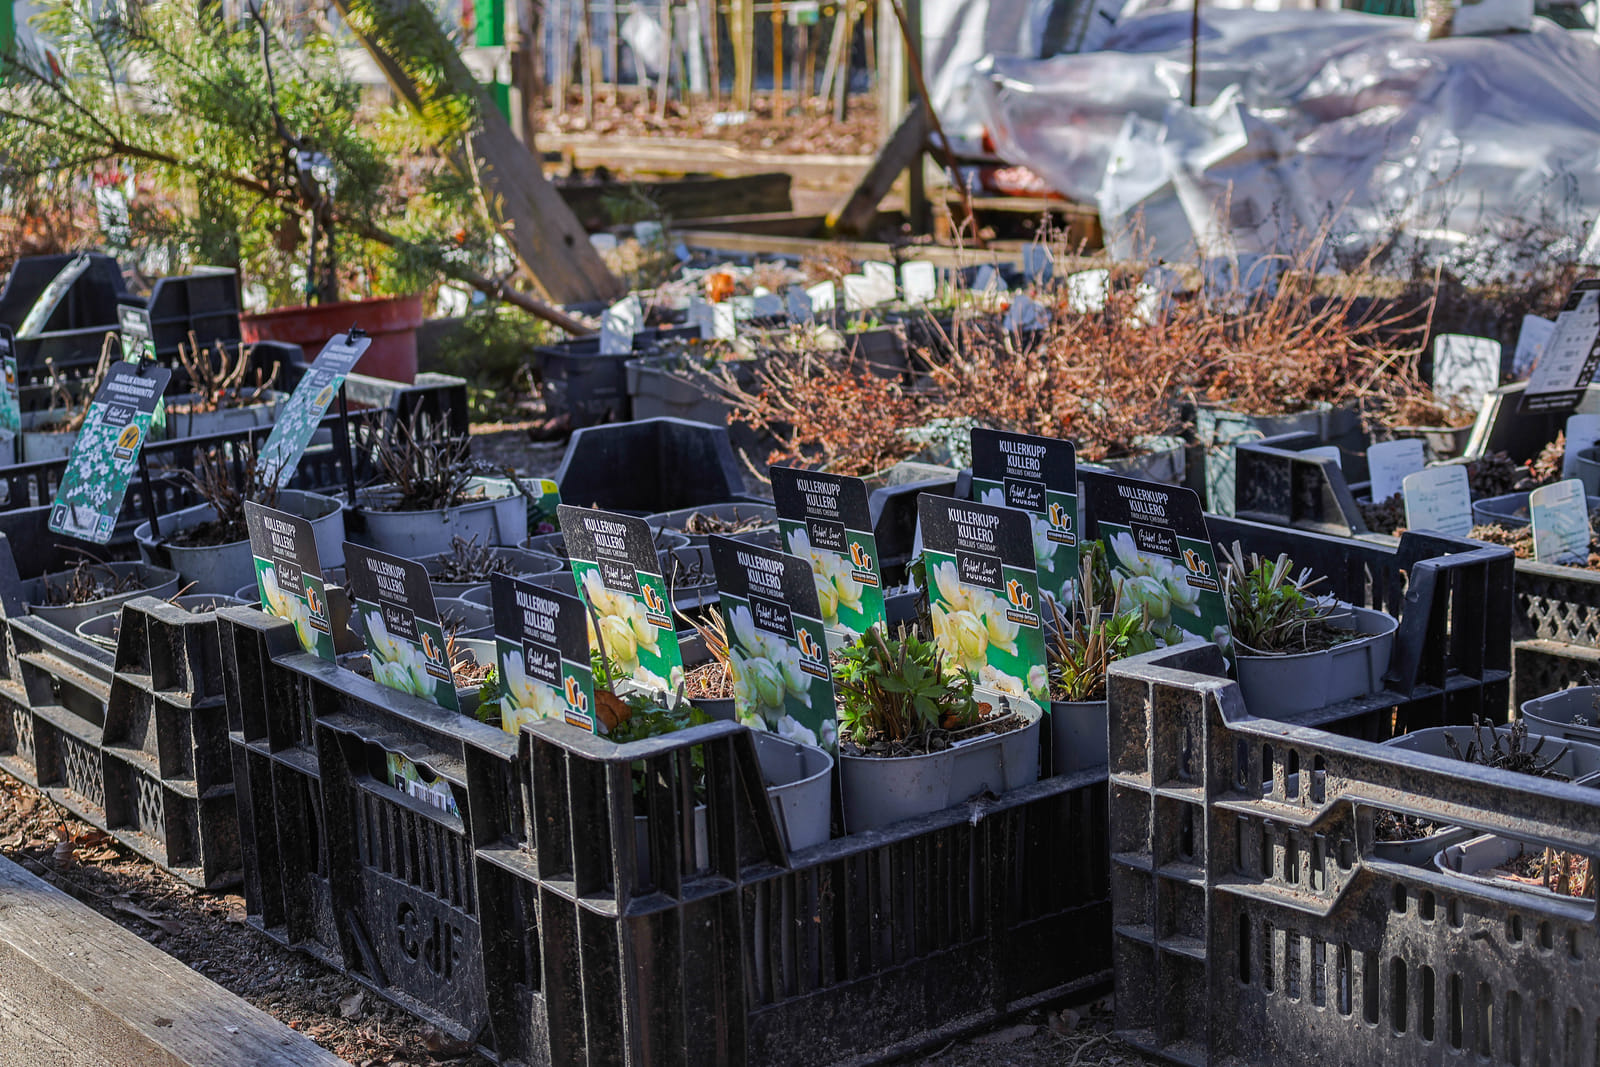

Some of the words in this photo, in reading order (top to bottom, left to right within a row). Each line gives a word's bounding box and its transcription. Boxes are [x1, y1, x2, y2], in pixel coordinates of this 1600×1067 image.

[1000, 440, 1046, 458] KULLERKUPP
[1007, 455, 1040, 470] KULLERO
[1007, 467, 1023, 476] TROLLIUS
[797, 479, 840, 496] KULLERKUPP
[1117, 485, 1169, 505] KULLERKUPP
[806, 494, 836, 509] KULLERO
[1012, 498, 1039, 507] PUUKOOL
[1129, 499, 1166, 517] KULLERO
[948, 508, 999, 529] KULLERKUPP
[1131, 512, 1149, 520] TROLLIUS
[264, 516, 296, 537] KULLERKUPP
[583, 518, 627, 537] KULLERKUPP
[958, 525, 993, 543] KULLERO
[271, 532, 294, 551] KULLERO
[594, 533, 625, 550] KULLERO
[816, 538, 840, 547] PUUKOOL
[957, 538, 975, 549] TROLLIUS
[1143, 543, 1172, 552] PUUKOOL
[366, 557, 406, 581] KULLERKUPP
[737, 551, 784, 576] KULLERKUPP
[376, 575, 404, 594] KULLERO
[607, 578, 633, 588] PUUKOOL
[747, 569, 781, 589] KULLERO
[966, 572, 995, 584] PUUKOOL
[749, 583, 765, 593] TROLLIUS
[515, 590, 560, 618] KULLERKUPP
[390, 623, 413, 635] PUUKOOL
[524, 611, 554, 634] KULLERO
[760, 619, 787, 632] PUUKOOL
[531, 665, 555, 679] PUUKOOL
